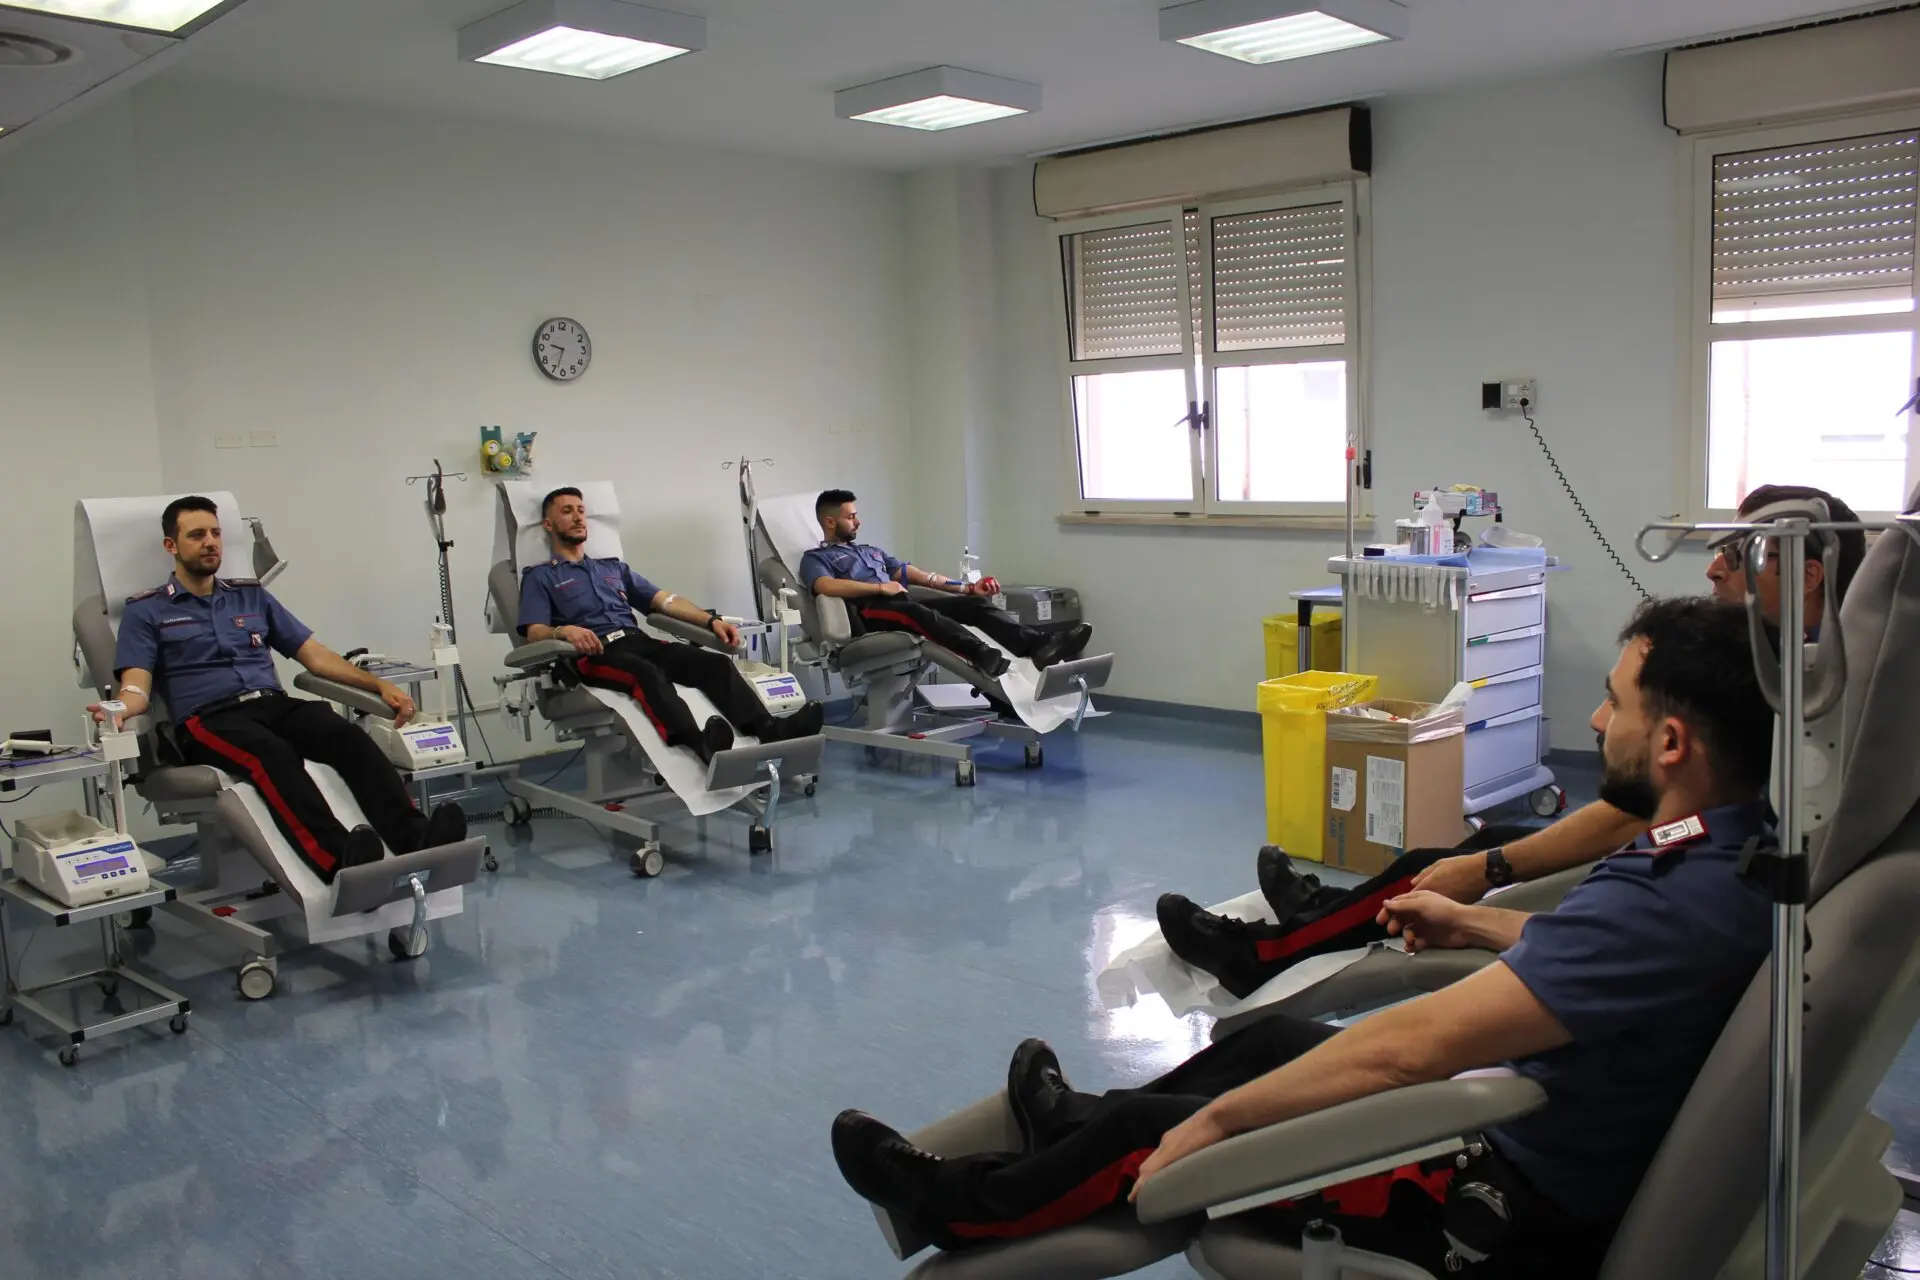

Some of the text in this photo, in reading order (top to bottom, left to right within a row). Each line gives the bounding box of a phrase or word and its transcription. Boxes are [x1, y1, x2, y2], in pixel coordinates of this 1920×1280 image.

[550, 324, 555, 333] 11
[558, 321, 567, 331] 12
[541, 333, 550, 341] 10
[577, 334, 583, 343] 2
[538, 343, 545, 352] 9
[580, 345, 587, 355] 3
[542, 355, 549, 364] 8
[577, 358, 583, 366] 4
[551, 364, 557, 374] 7
[560, 368, 567, 377] 6
[570, 365, 576, 374] 5
